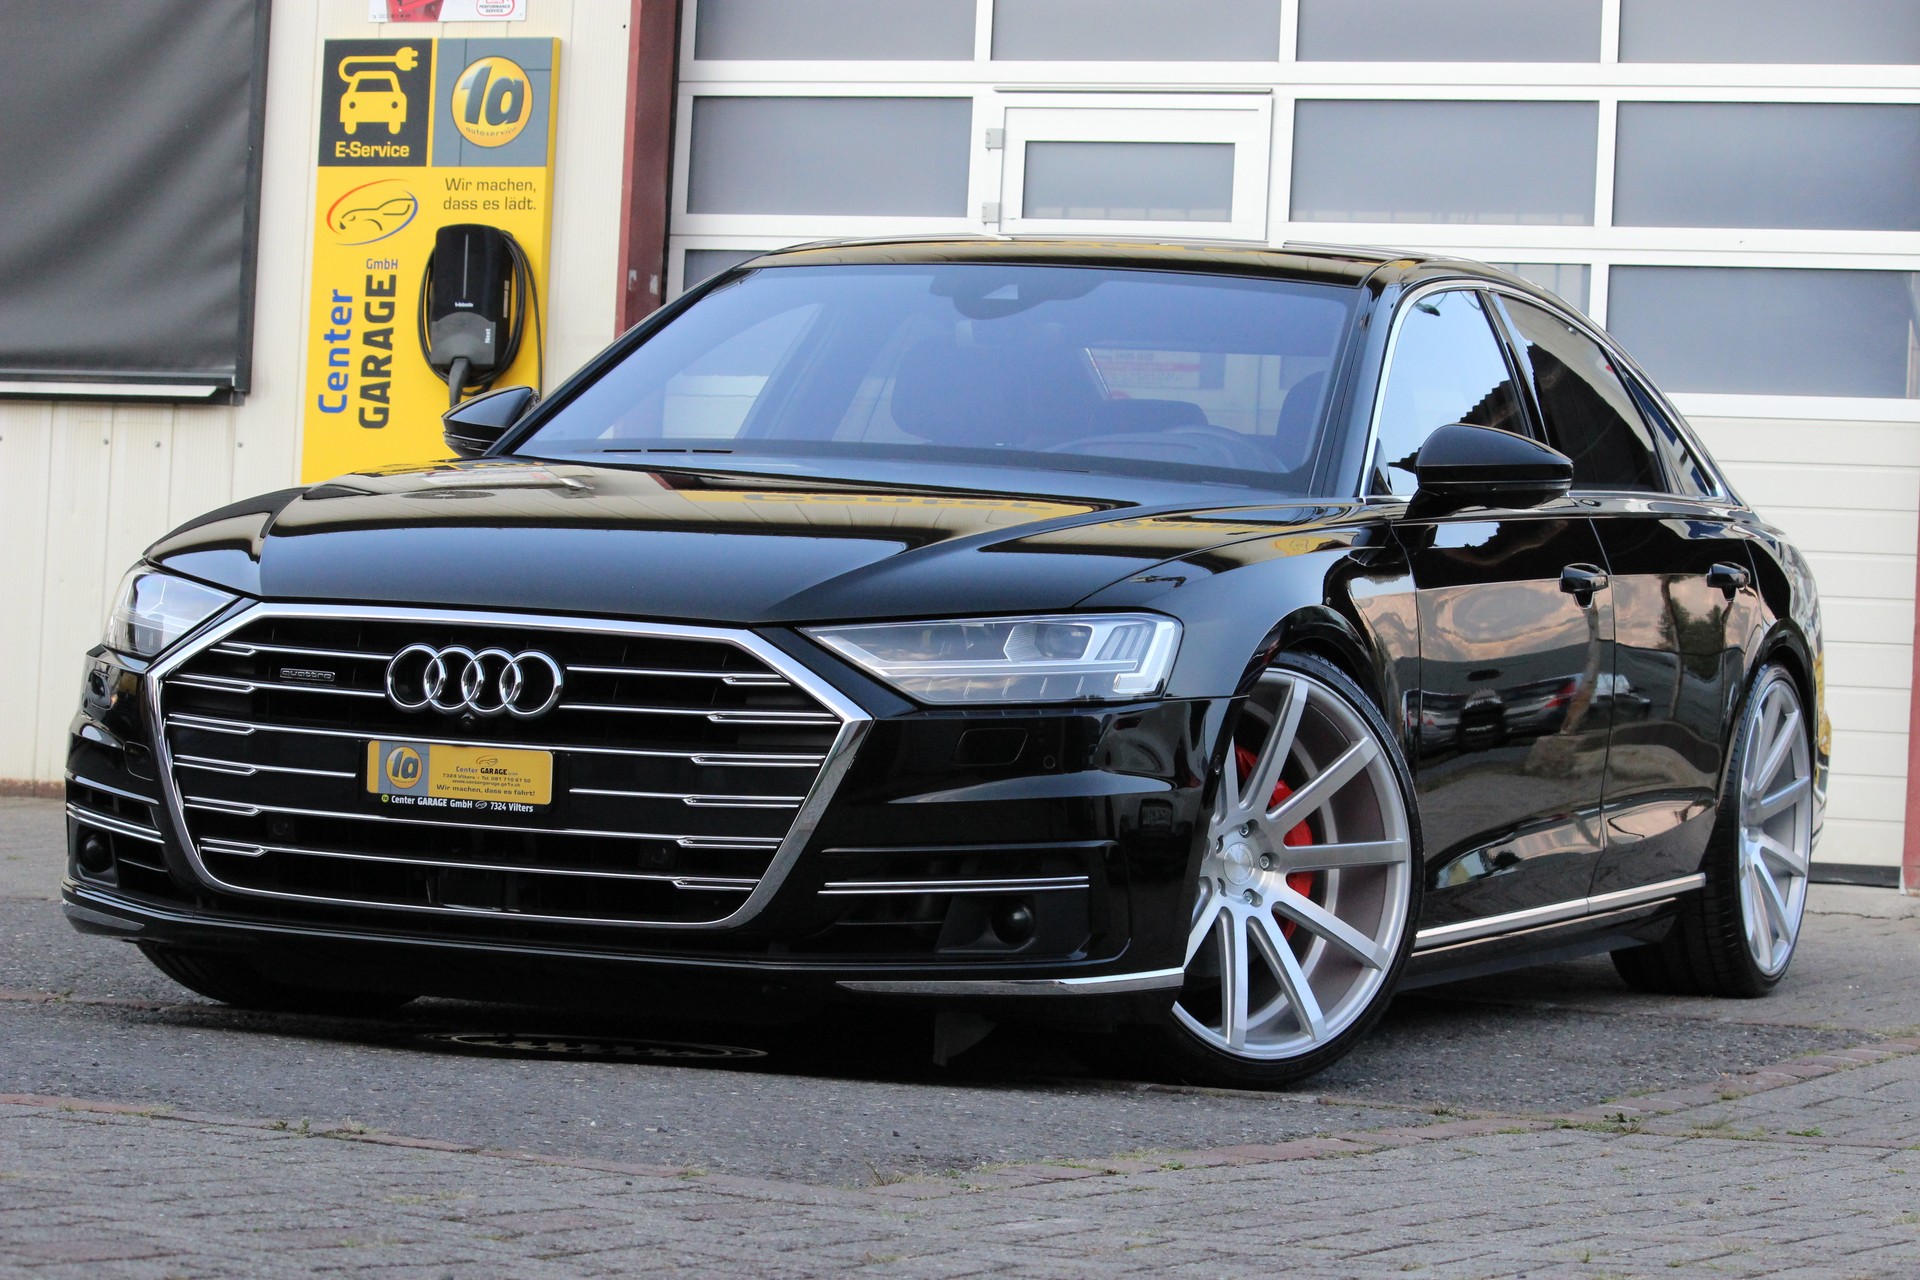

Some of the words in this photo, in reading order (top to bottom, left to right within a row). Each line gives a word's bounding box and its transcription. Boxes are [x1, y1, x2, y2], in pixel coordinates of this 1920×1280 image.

[460, 65, 525, 127] 1a
[334, 141, 410, 158] E-Service
[445, 178, 472, 191] Wir
[476, 178, 537, 193] machen,
[443, 196, 478, 210] dass
[482, 199, 500, 210] es
[504, 196, 537, 210] lädt.
[366, 258, 399, 270] GmbH
[318, 288, 353, 414] Center
[358, 274, 398, 429] GARAGE
[282, 670, 332, 679] quattro
[391, 750, 419, 779] 1a
[480, 767, 508, 775] GARAGE
[452, 786, 483, 794] machen,
[391, 795, 416, 805] Center
[417, 796, 448, 807] GARAGE
[450, 799, 473, 808] GmbH
[490, 801, 507, 811] 7324
[508, 802, 534, 813] Vilters
